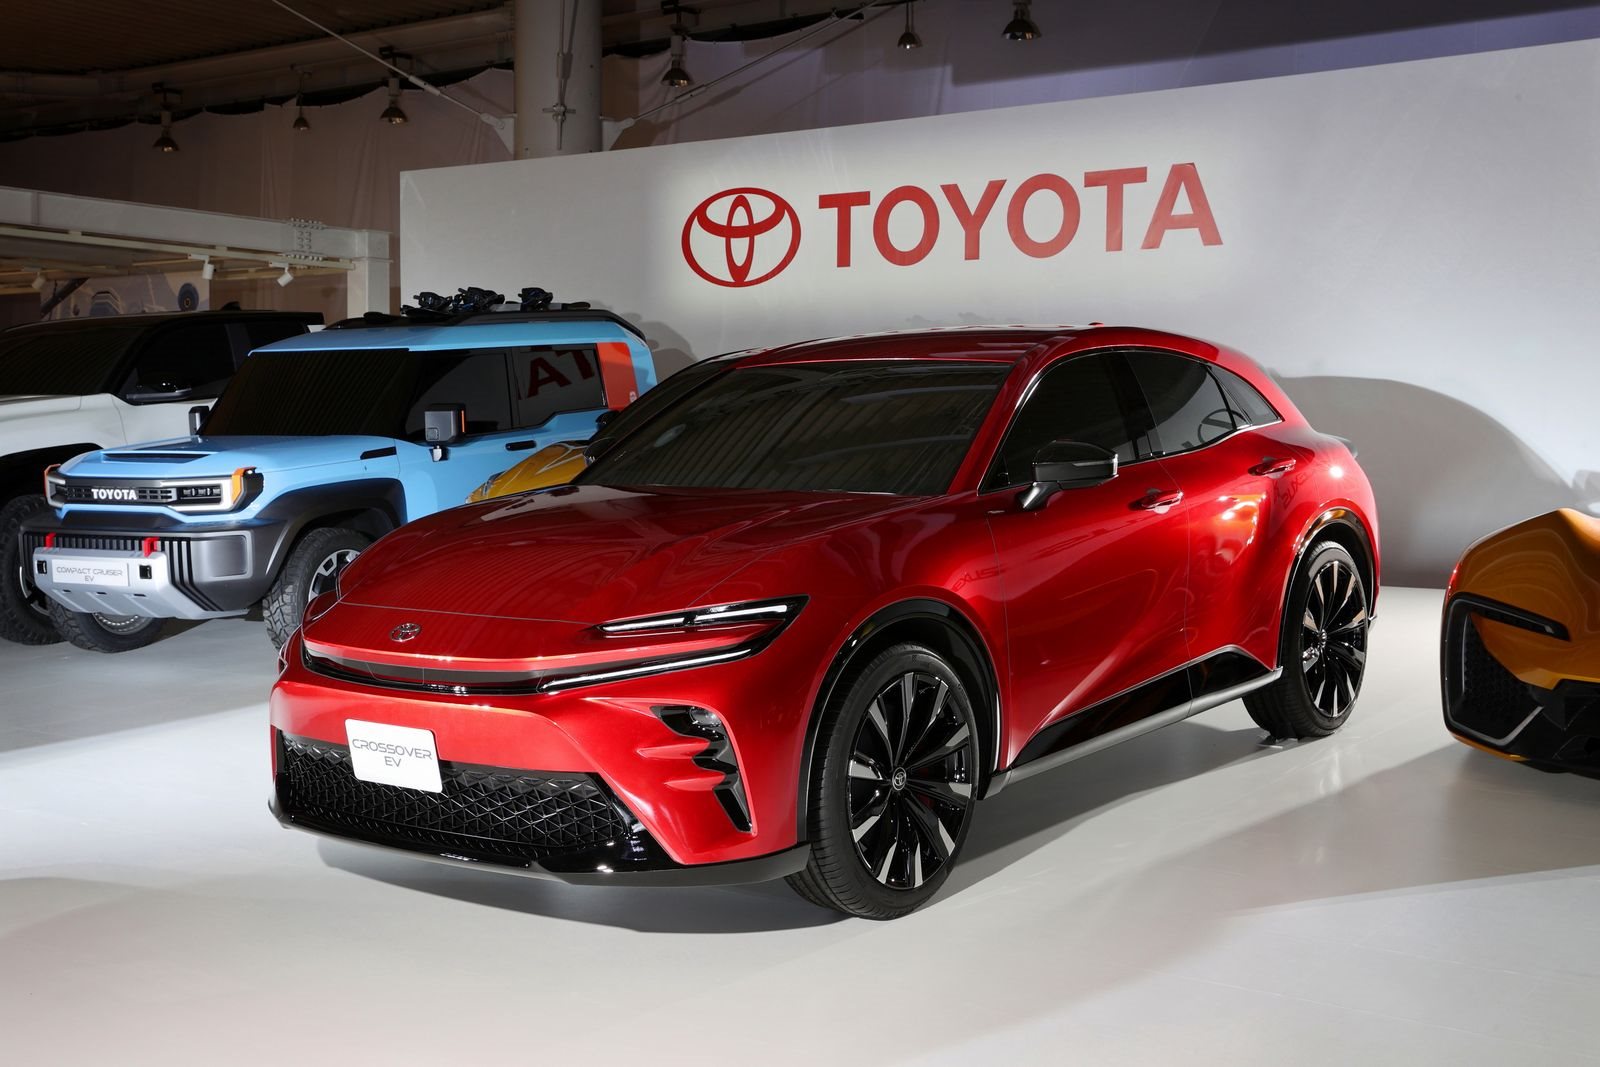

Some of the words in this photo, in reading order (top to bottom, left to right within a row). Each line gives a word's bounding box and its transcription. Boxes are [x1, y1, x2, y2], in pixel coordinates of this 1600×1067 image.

[818, 162, 1223, 268] TOYOTA
[91, 487, 137, 500] TOYOTA
[56, 566, 91, 575] COMPACT
[92, 568, 123, 576] CRUISER
[351, 738, 433, 760] CROSSOVER
[384, 755, 402, 767] EV
